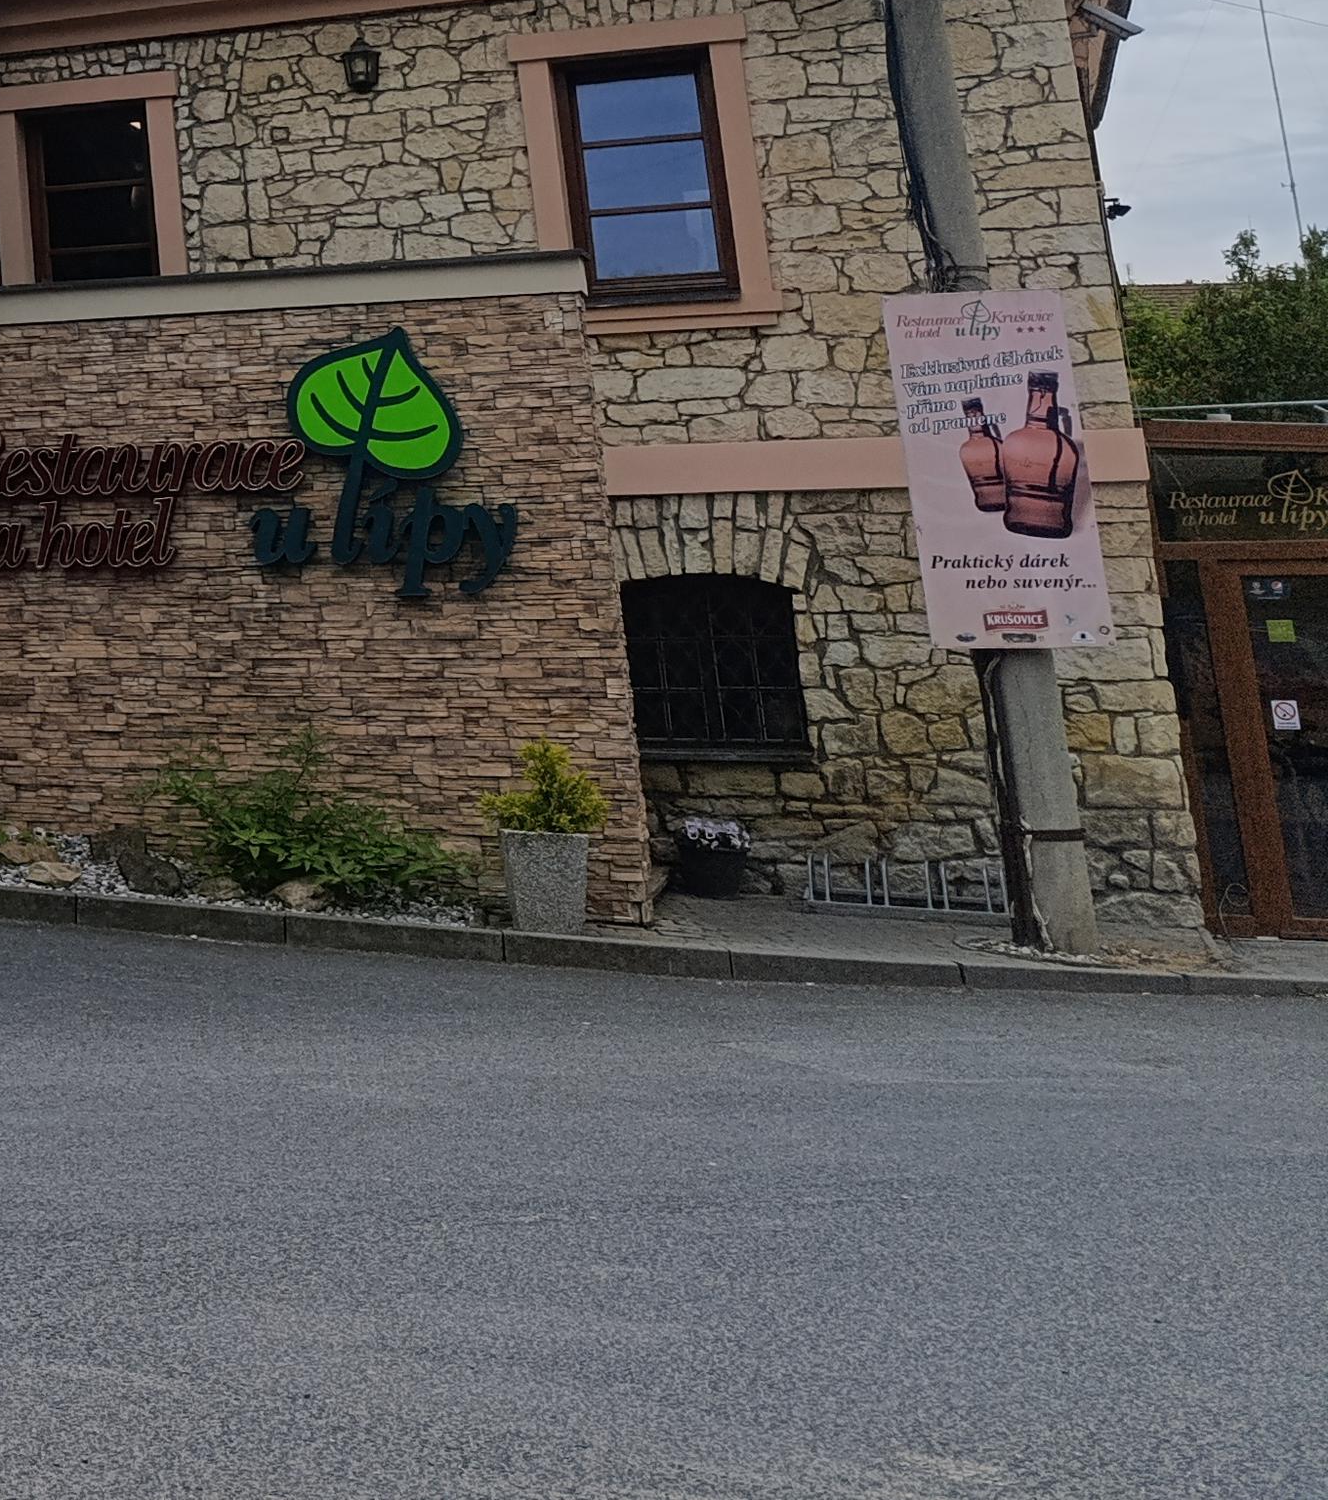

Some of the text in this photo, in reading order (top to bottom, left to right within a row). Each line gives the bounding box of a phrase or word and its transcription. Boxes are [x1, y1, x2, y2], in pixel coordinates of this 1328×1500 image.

[896, 309, 1055, 328] Restaurace Krušovice
[904, 326, 941, 339] a hotel
[955, 327, 965, 337] u
[900, 345, 1064, 379] Exkluzivní džbánek
[902, 373, 1024, 397] Vám naplníme
[907, 399, 957, 419] přímo
[909, 411, 1007, 435] od pramene
[1168, 491, 1273, 509] Restaurace
[1182, 509, 1238, 527] a hotel
[1258, 510, 1275, 525] u
[36, 496, 177, 569] hotel
[249, 465, 517, 597] u lípy
[930, 553, 1071, 572] Praktický dárek
[965, 574, 1097, 592] nebo suvenýr...
[986, 613, 1044, 625] KRUŠOVICE
